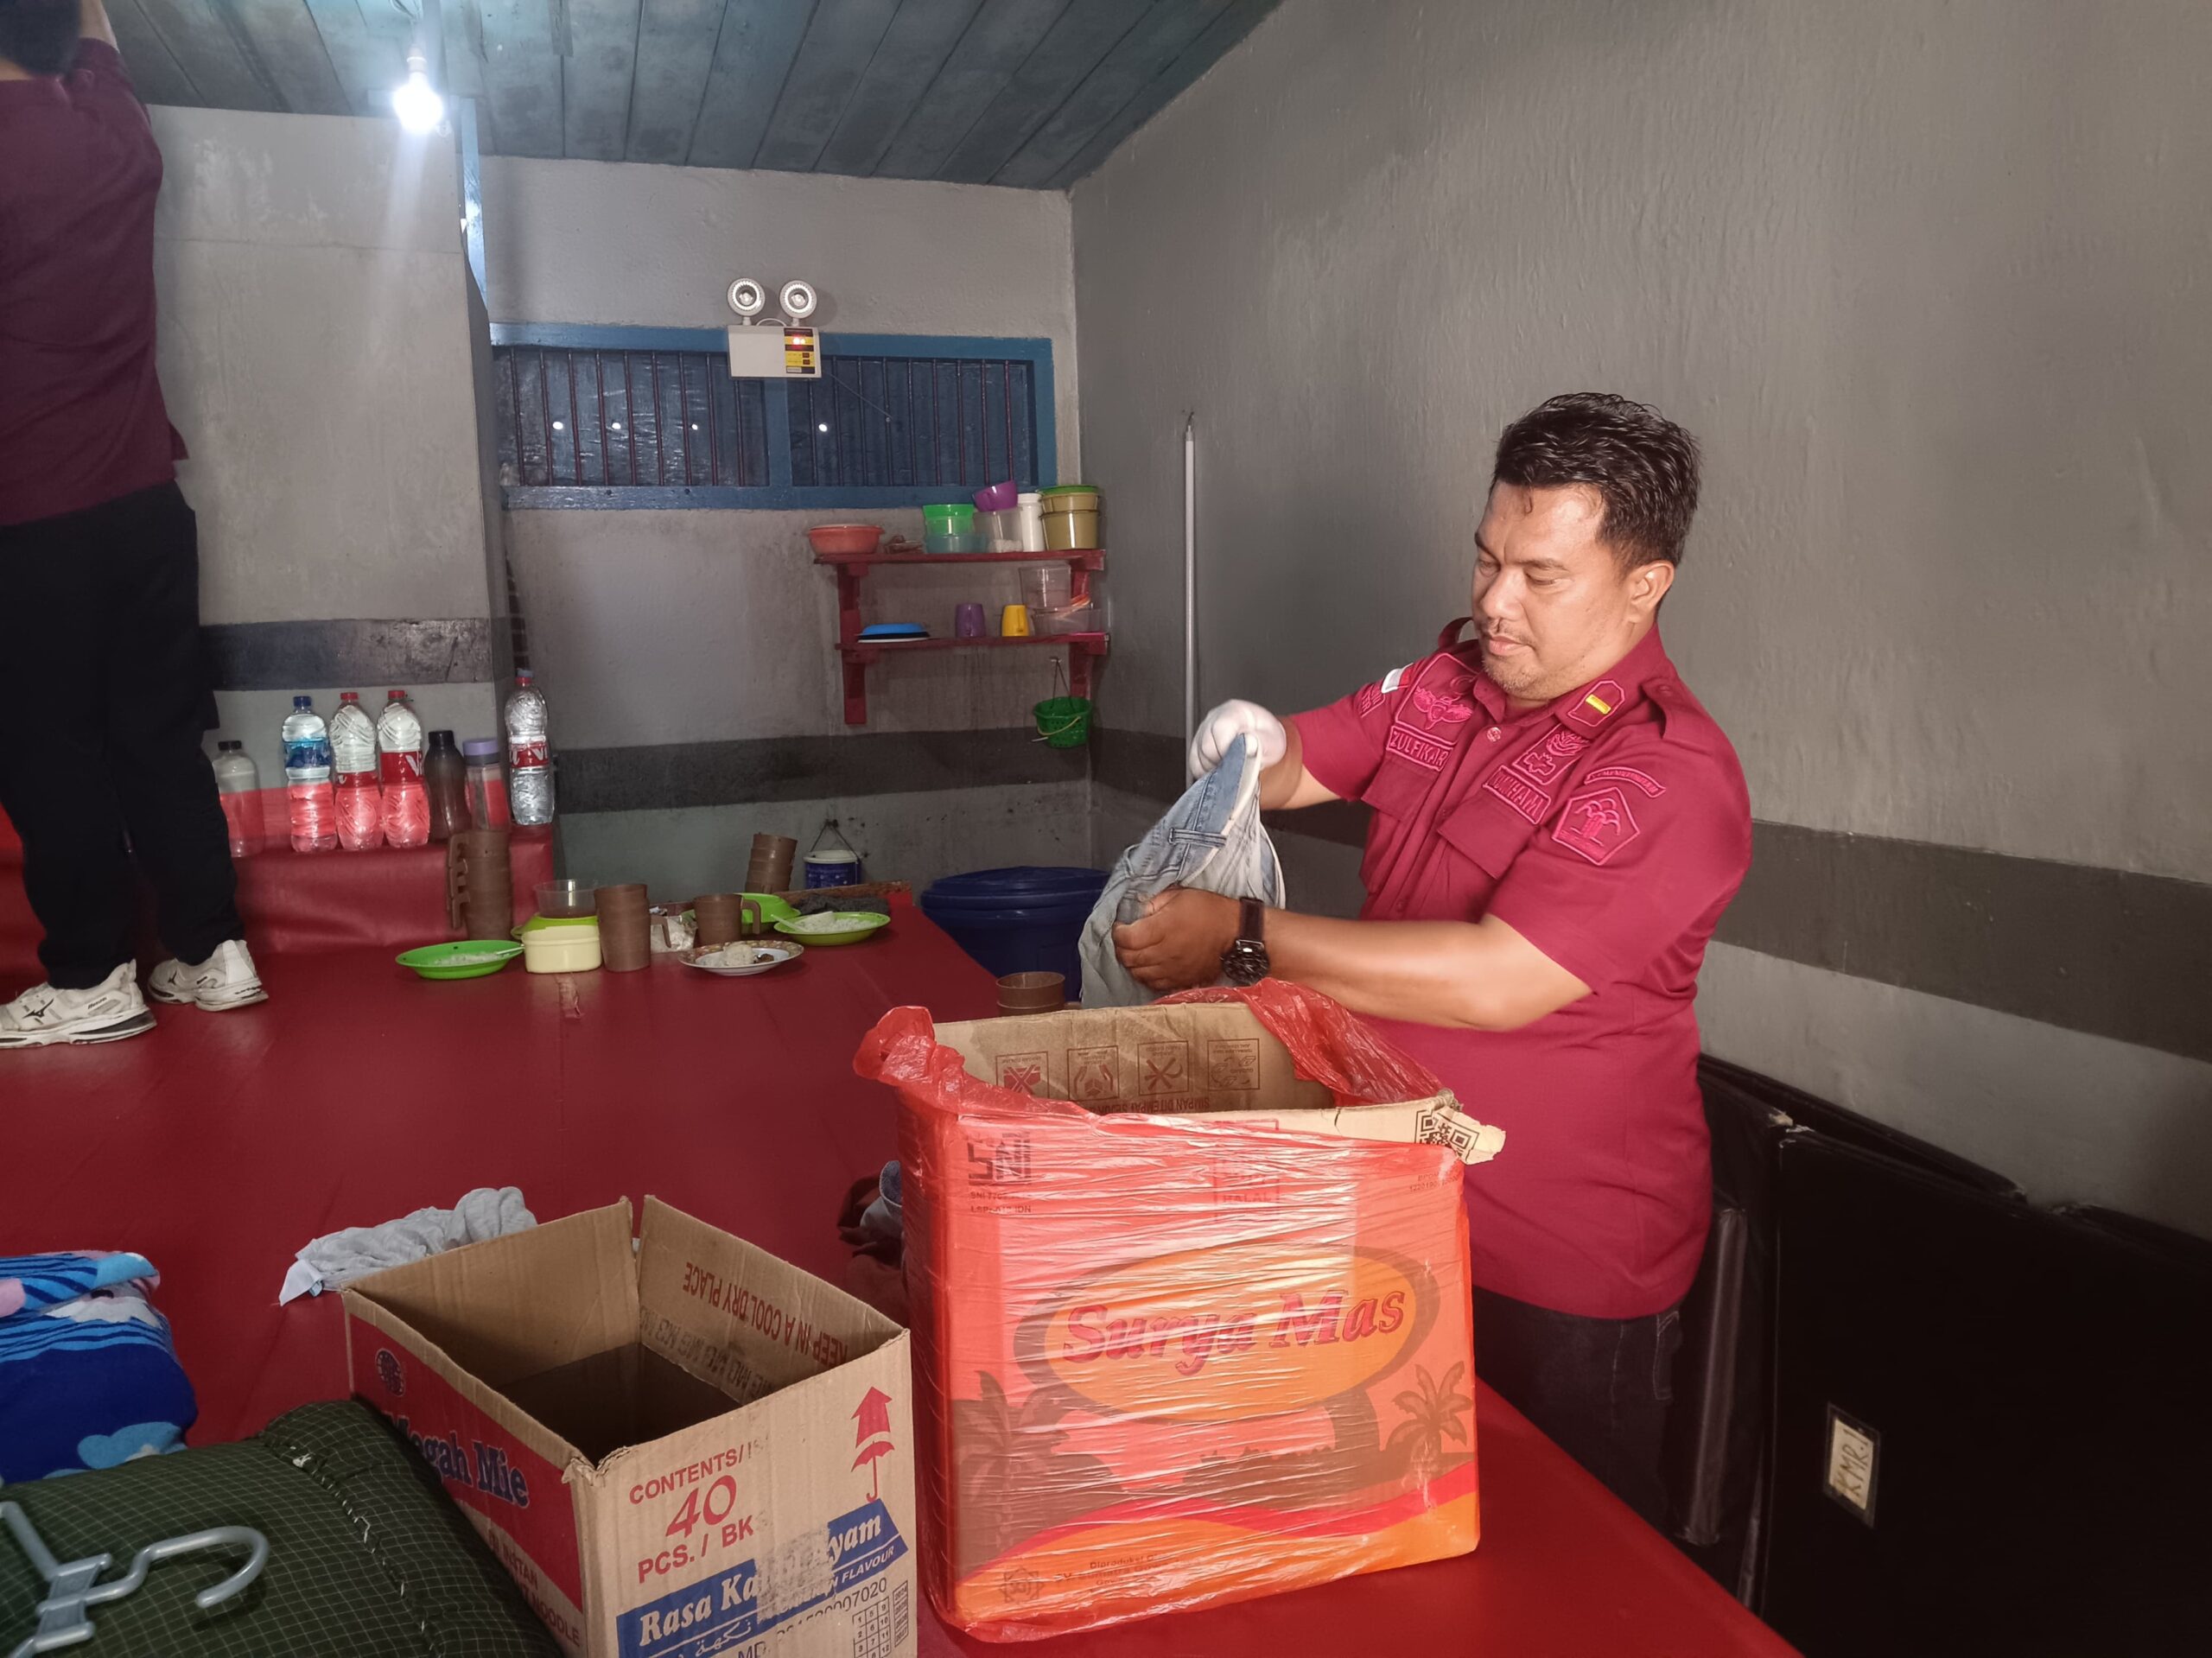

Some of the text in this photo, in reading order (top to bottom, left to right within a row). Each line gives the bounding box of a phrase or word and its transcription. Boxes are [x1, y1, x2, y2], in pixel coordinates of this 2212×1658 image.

[1389, 730, 1449, 766] ZULFIKAR
[683, 1261, 849, 1368] KEEP IN A COOL DRY PLACE
[1063, 1288, 1406, 1375] Surya Mas
[472, 1439, 531, 1509] Mie
[665, 1475, 737, 1538] 40
[638, 1544, 695, 1584] PCS.
[639, 1594, 712, 1647] Rasa
[826, 1515, 881, 1566] yam
[841, 1545, 895, 1584] FLAVOUR
